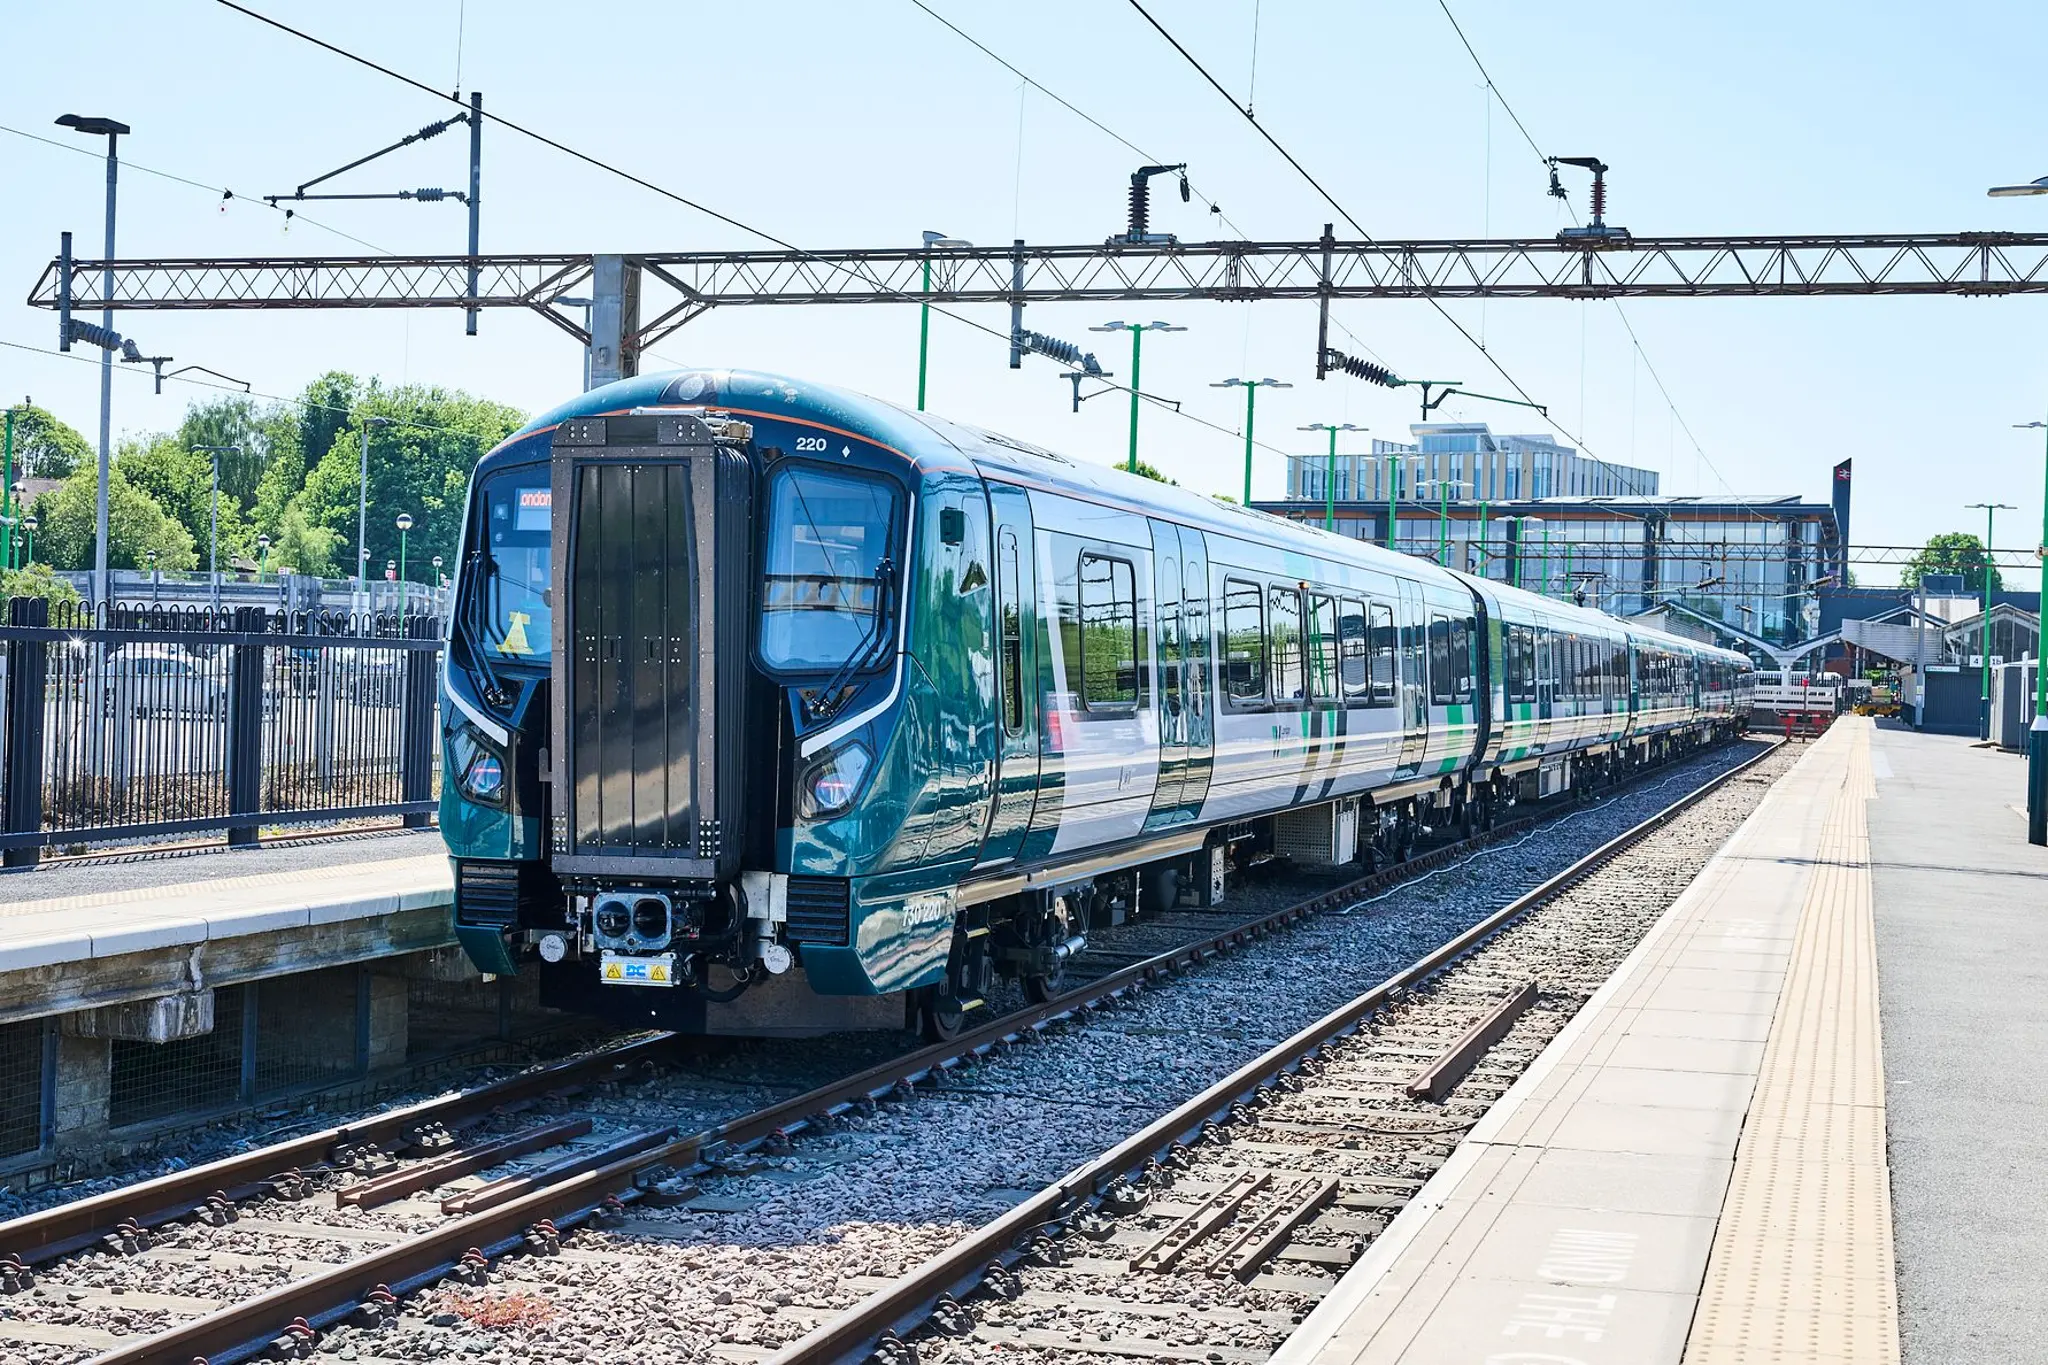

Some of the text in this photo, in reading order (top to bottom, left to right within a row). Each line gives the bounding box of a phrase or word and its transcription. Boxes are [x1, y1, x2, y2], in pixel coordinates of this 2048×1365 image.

[795, 437, 827, 452] 220
[520, 491, 552, 506] ondon
[1535, 1228, 1639, 1283] MIND
[1501, 1294, 1618, 1341] THE
